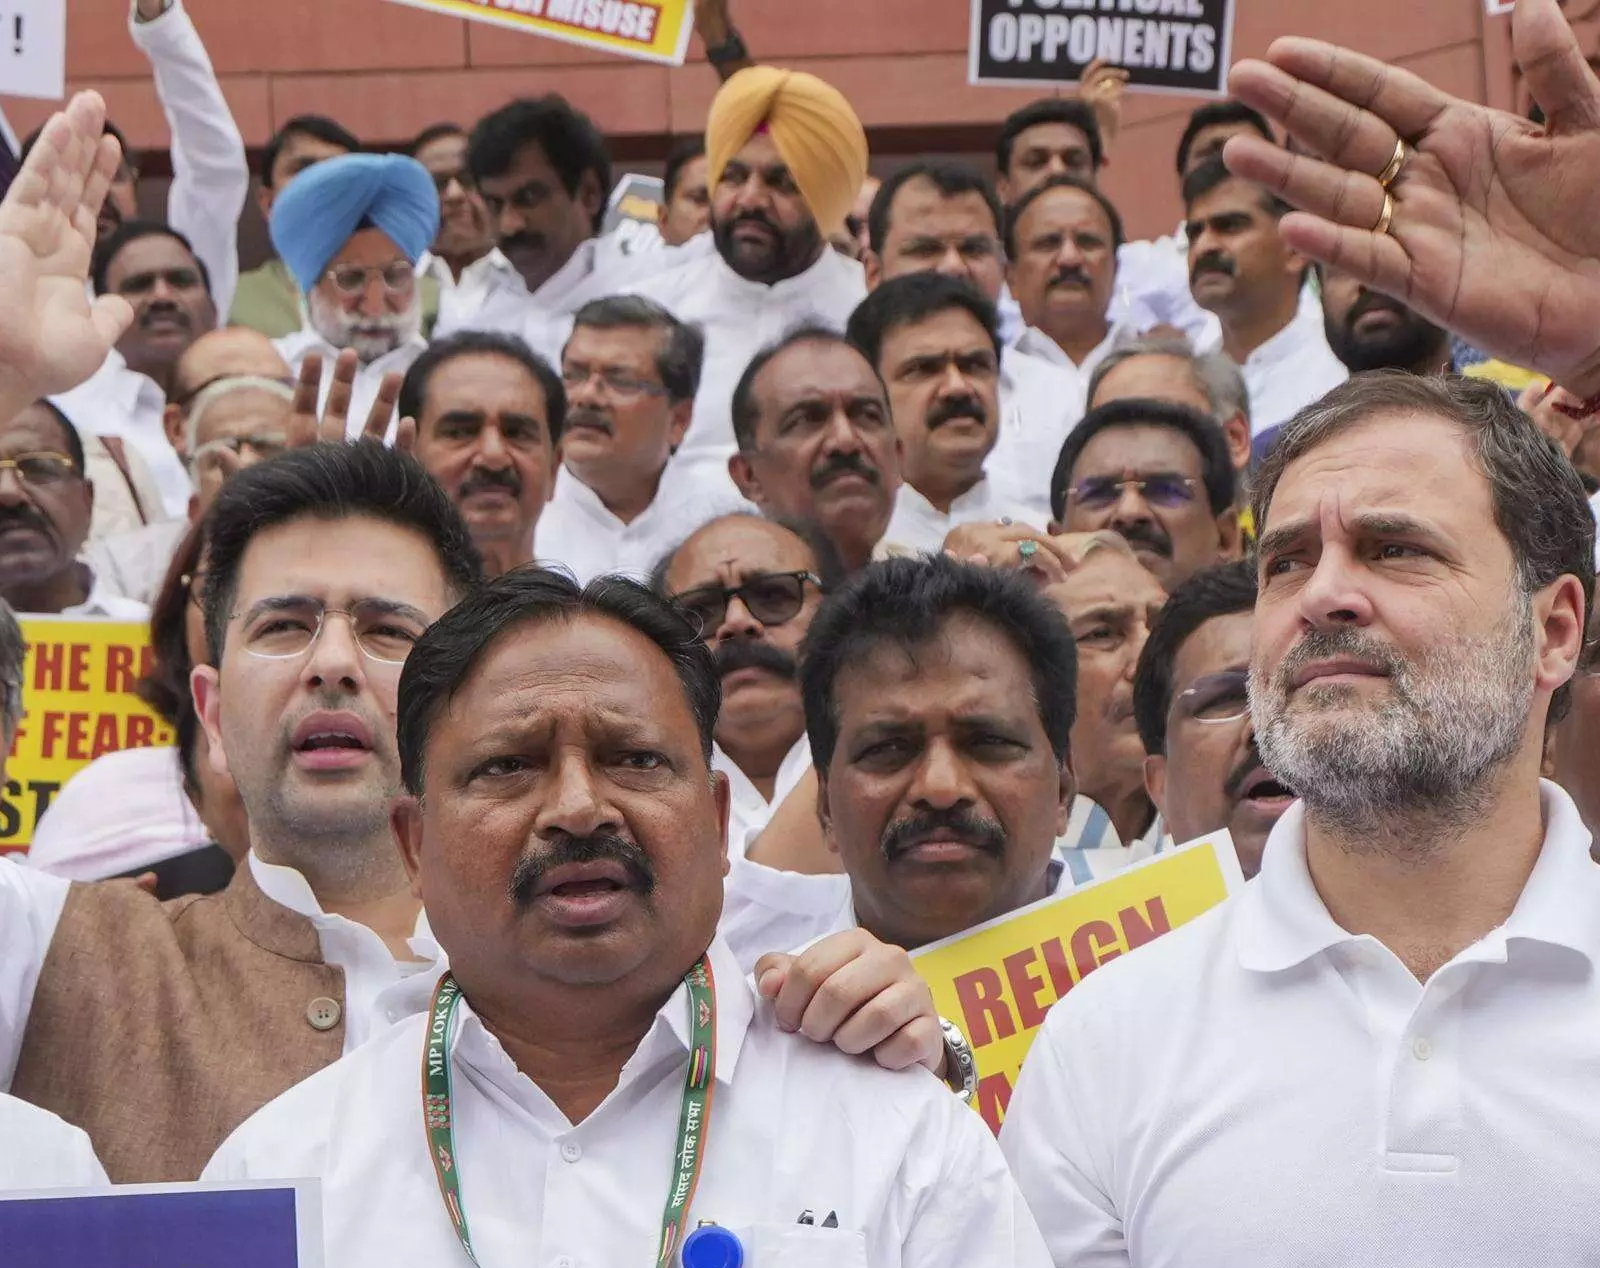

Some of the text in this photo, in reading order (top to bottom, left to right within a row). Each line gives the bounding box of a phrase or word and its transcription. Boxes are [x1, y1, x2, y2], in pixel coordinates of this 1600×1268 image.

[545, 0, 658, 41] MISUSE
[988, 12, 1217, 74] OPPONENTS
[22, 643, 92, 693] HE
[430, 1006, 449, 1044] LOK
[428, 1047, 444, 1077] MP
